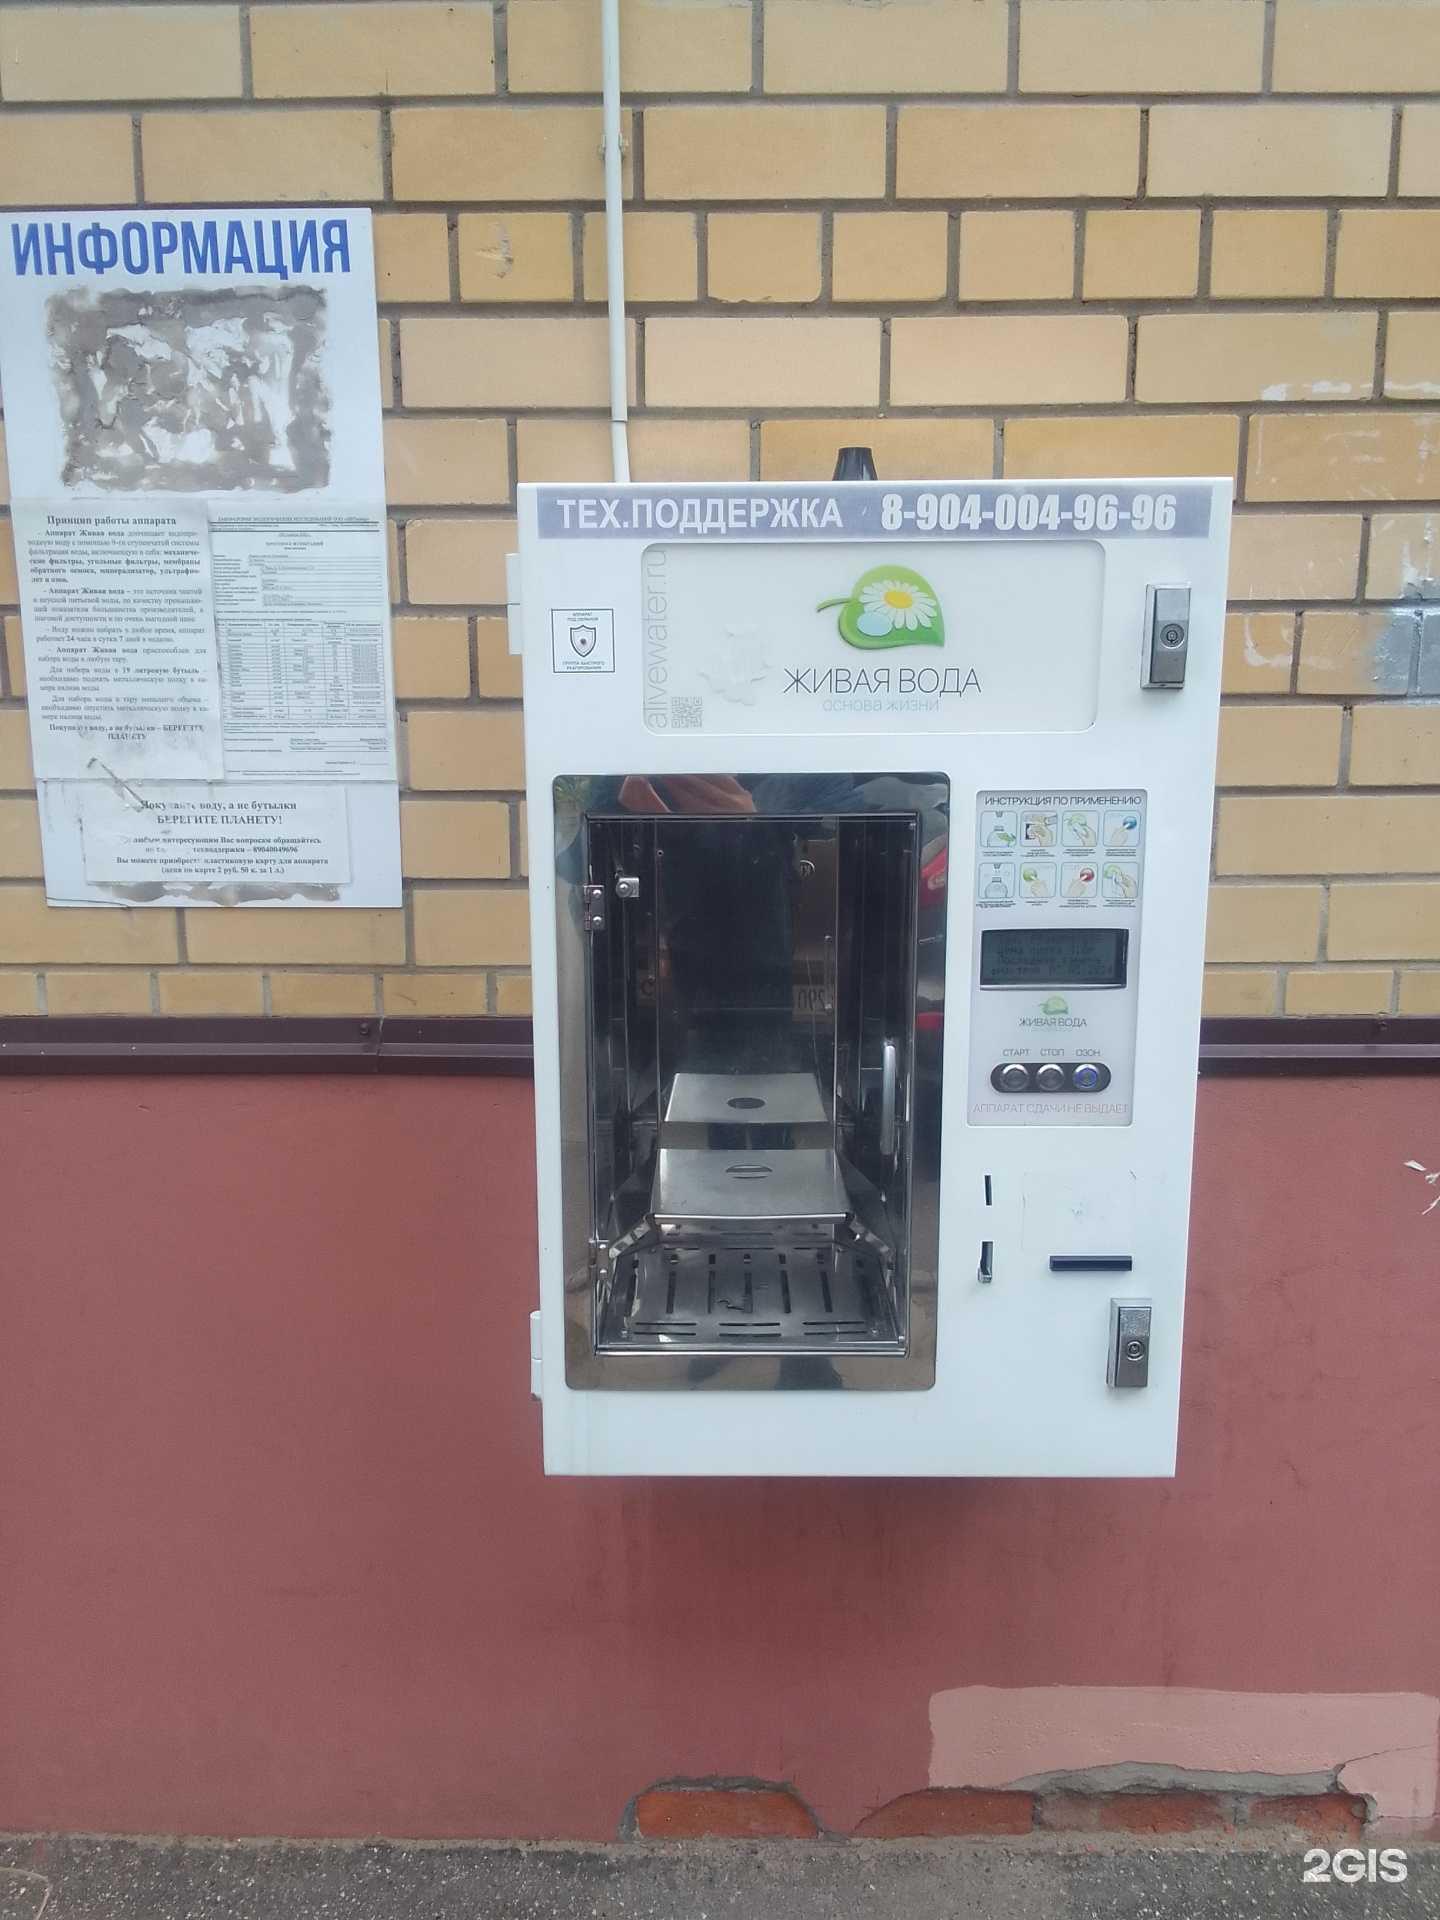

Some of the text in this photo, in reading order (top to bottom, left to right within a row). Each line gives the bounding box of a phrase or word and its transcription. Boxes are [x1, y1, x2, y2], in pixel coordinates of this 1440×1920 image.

[12, 219, 351, 280] ИНФОРМАЦИЯ
[557, 494, 1177, 534] ТЕХ.ПОДДЕРЖКА 8-904-004-96-96
[47, 515, 177, 526] Принцип работы аппарата
[643, 550, 667, 729] alivewater.ru
[784, 668, 981, 698] ЖИВАЯ ВОДА
[200, 802, 226, 811] воду,
[252, 801, 296, 811] бутылки
[985, 796, 1142, 806] ИНСТРУКЦИЯ ПО ПРИМЕНЕНИЮ
[158, 815, 282, 824] БЕРЕГИТЕ ПЛАНЕТУ!
[1019, 1018, 1087, 1028] ЖИВАЯ ВОДА
[973, 1104, 1128, 1113] АППАРАТ СДАЧИ НЕ ВЫДАЕТ
